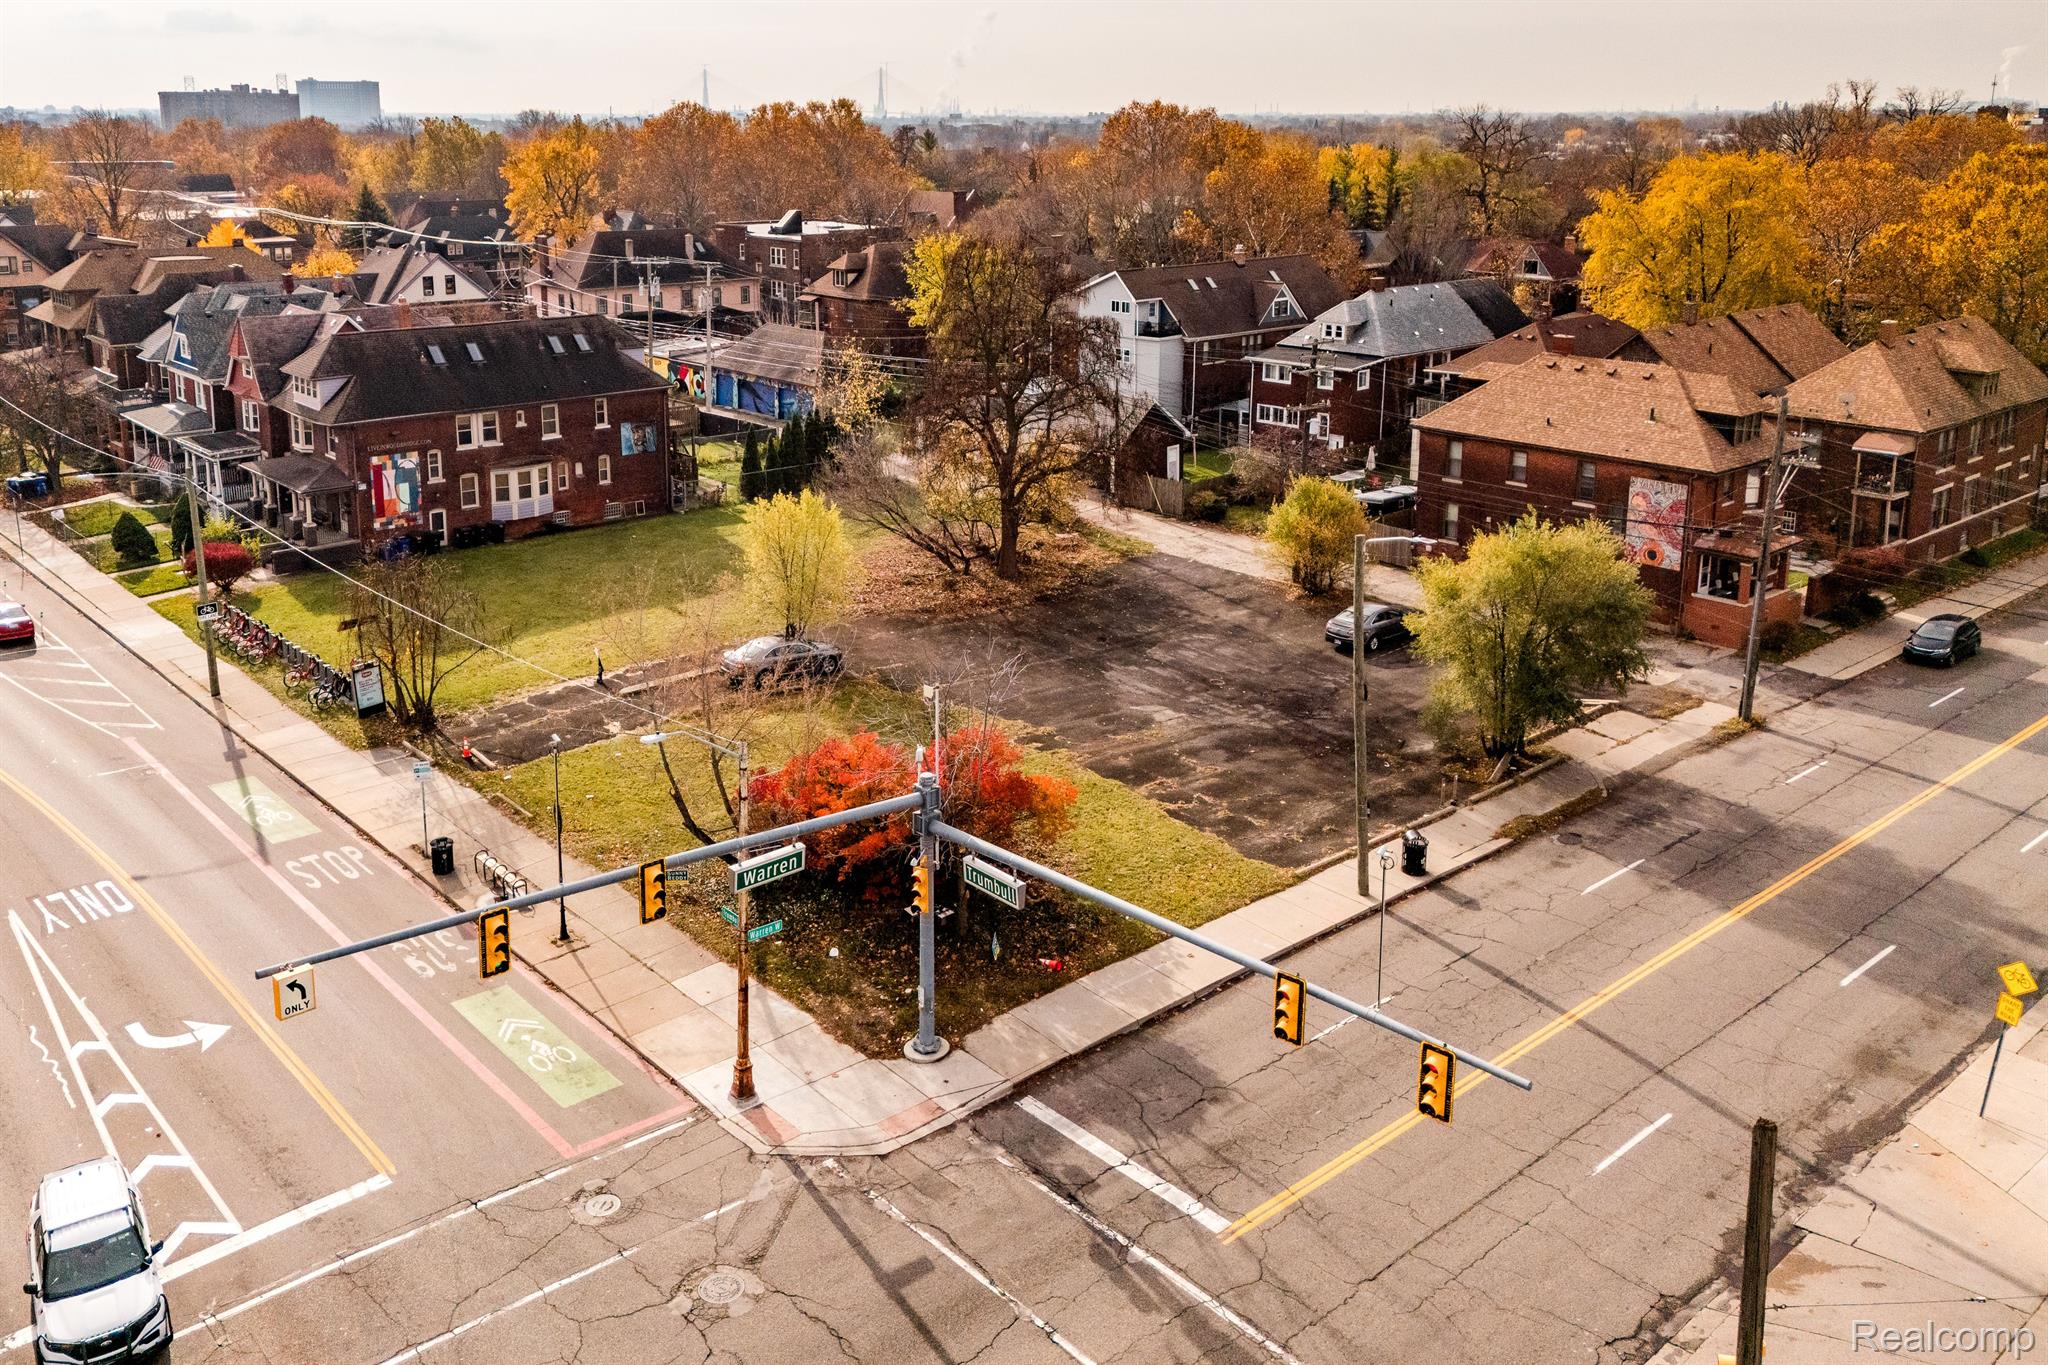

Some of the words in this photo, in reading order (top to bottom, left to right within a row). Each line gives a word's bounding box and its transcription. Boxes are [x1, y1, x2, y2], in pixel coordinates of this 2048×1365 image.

[286, 846, 375, 889] STOP
[743, 857, 797, 886] Warren
[966, 866, 1016, 904] Trumbull
[33, 880, 135, 934] ONLY
[749, 926, 773, 939] Warren
[775, 920, 781, 931] W
[284, 999, 311, 1016] ONLY
